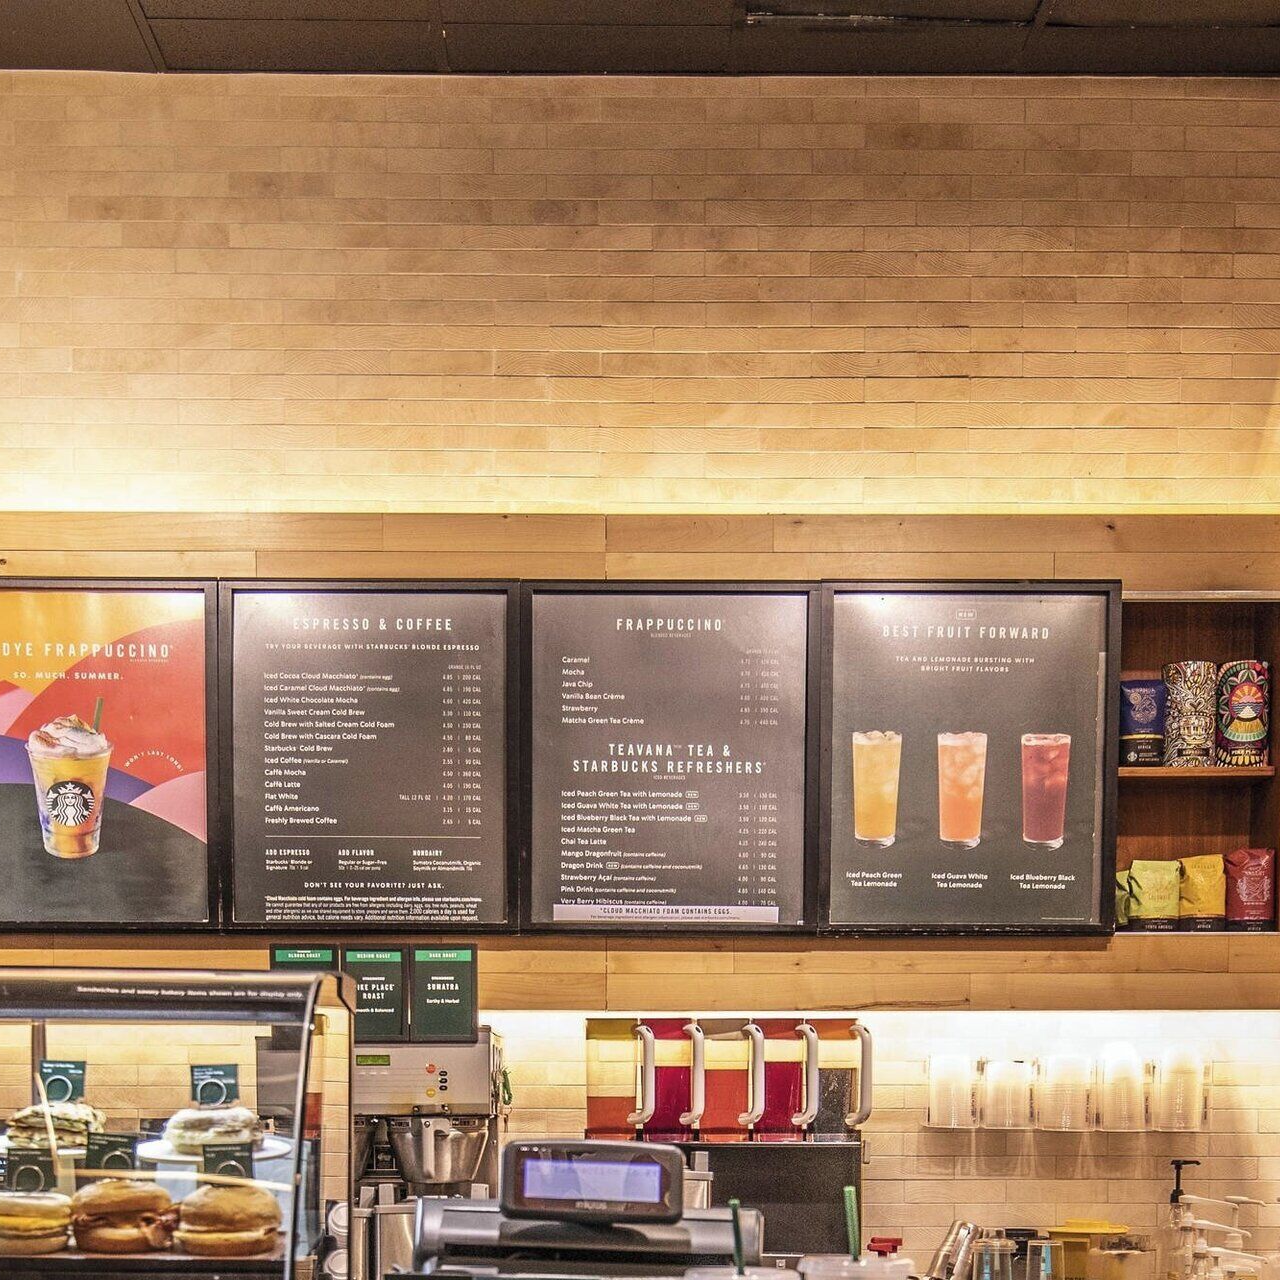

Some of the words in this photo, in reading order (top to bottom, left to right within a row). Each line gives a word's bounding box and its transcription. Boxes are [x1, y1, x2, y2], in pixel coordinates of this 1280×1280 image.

[294, 618, 369, 629] ESPRESSO
[379, 618, 386, 630] &
[396, 618, 452, 630] COFFEE
[882, 624, 918, 636] BEST
[927, 626, 971, 638] FRUIT
[979, 626, 1048, 638] FORWARD
[609, 744, 673, 756] TEAVANA
[688, 744, 714, 756] TEA
[723, 745, 731, 756] &
[573, 760, 658, 773] STARBUCKS
